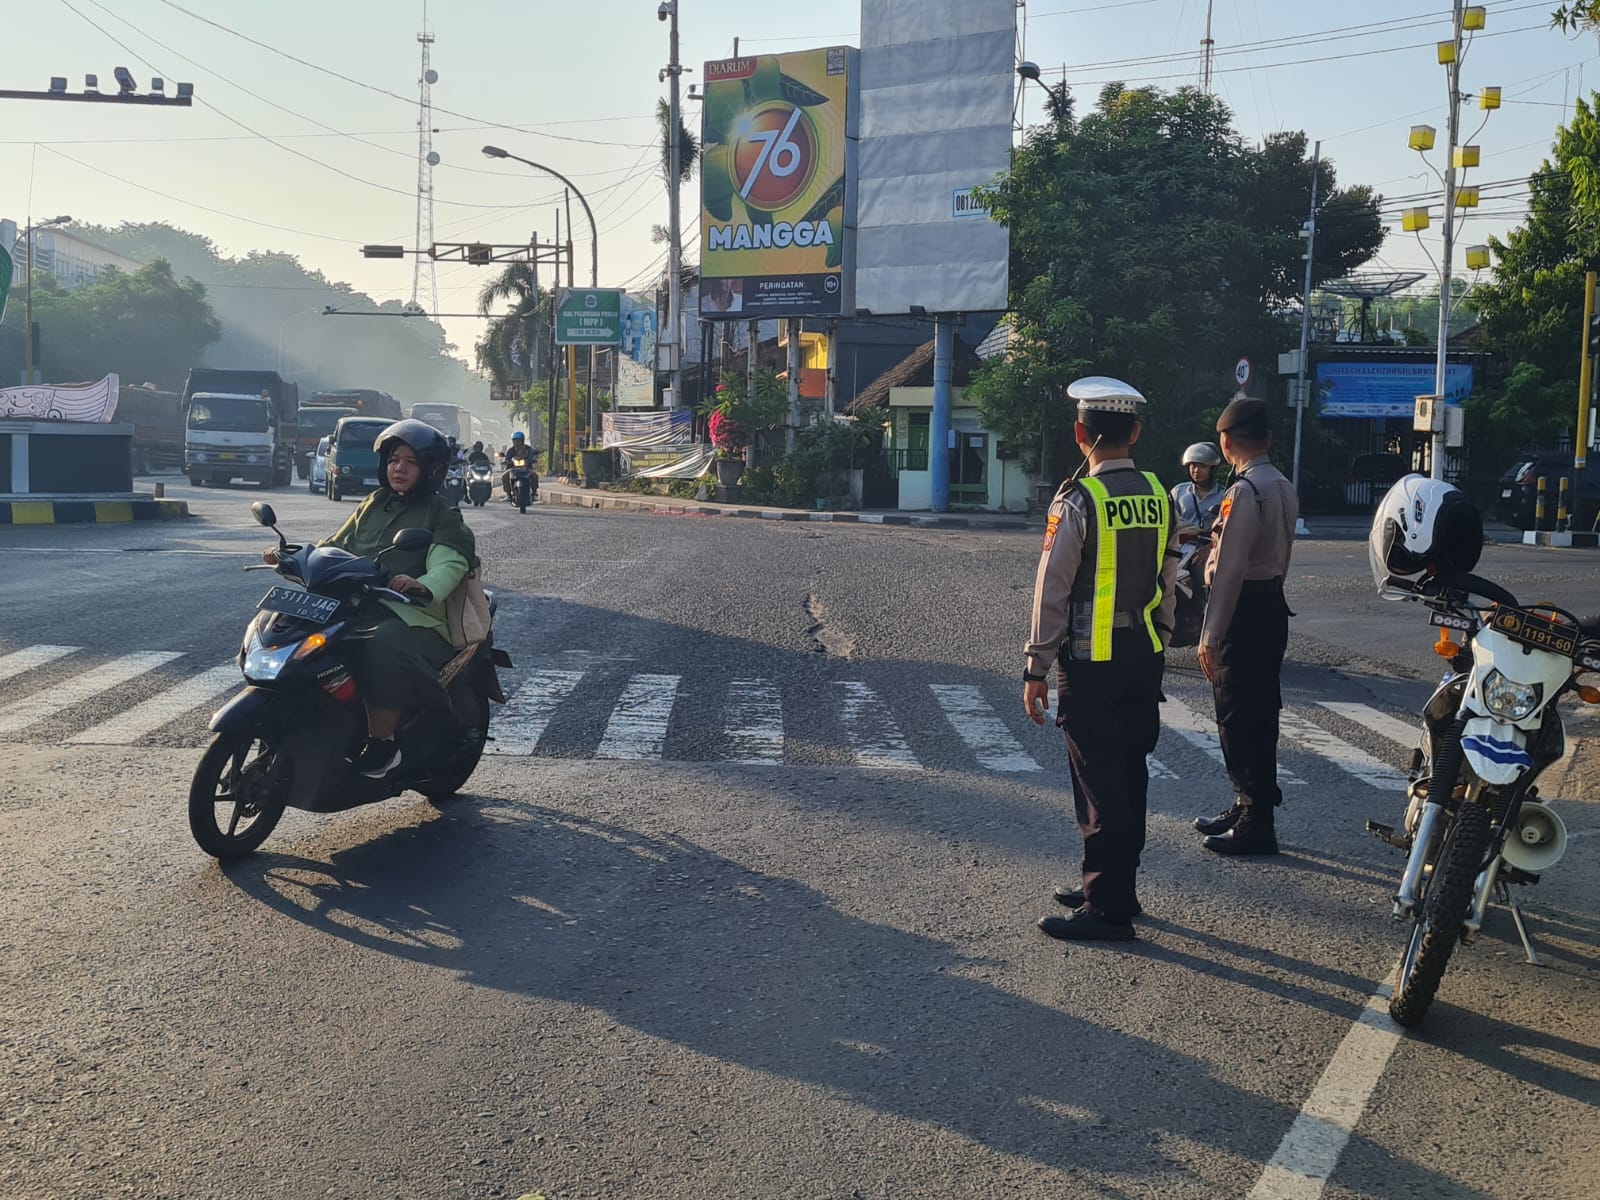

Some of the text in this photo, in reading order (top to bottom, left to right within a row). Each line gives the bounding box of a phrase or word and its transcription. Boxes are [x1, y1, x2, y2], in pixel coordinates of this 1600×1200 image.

[708, 60, 751, 76] DJARUM
[739, 107, 802, 201] 76
[709, 220, 834, 252] MANGGA
[1105, 498, 1163, 527] POLISI
[270, 588, 336, 611] S 5111 JAG
[1524, 627, 1571, 652] 1191-60
[1547, 623, 1555, 632] X
[317, 664, 345, 679] HONDA
